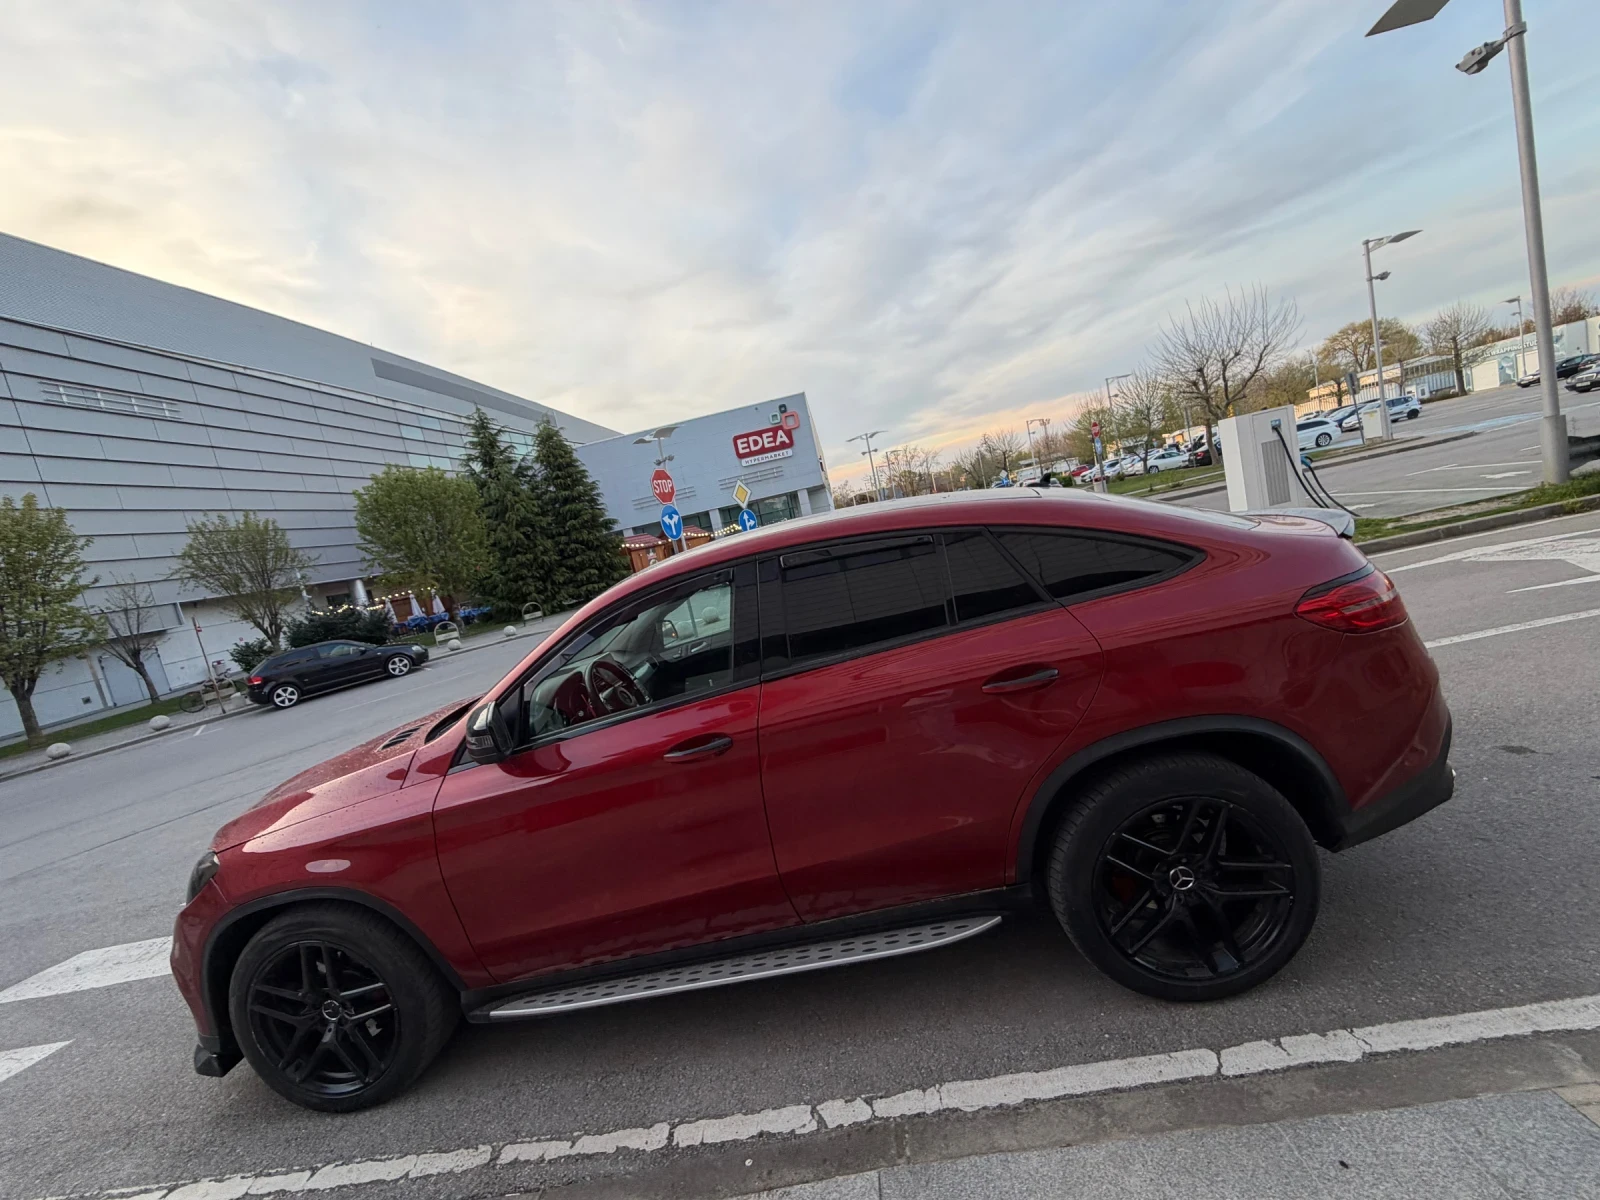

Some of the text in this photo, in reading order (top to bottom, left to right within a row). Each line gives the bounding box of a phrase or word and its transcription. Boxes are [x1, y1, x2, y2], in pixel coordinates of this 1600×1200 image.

[1491, 344, 1522, 356] WRAPPING
[736, 429, 790, 454] EDEA
[744, 450, 789, 465] HYPERMARKET
[653, 479, 673, 494] STOP
